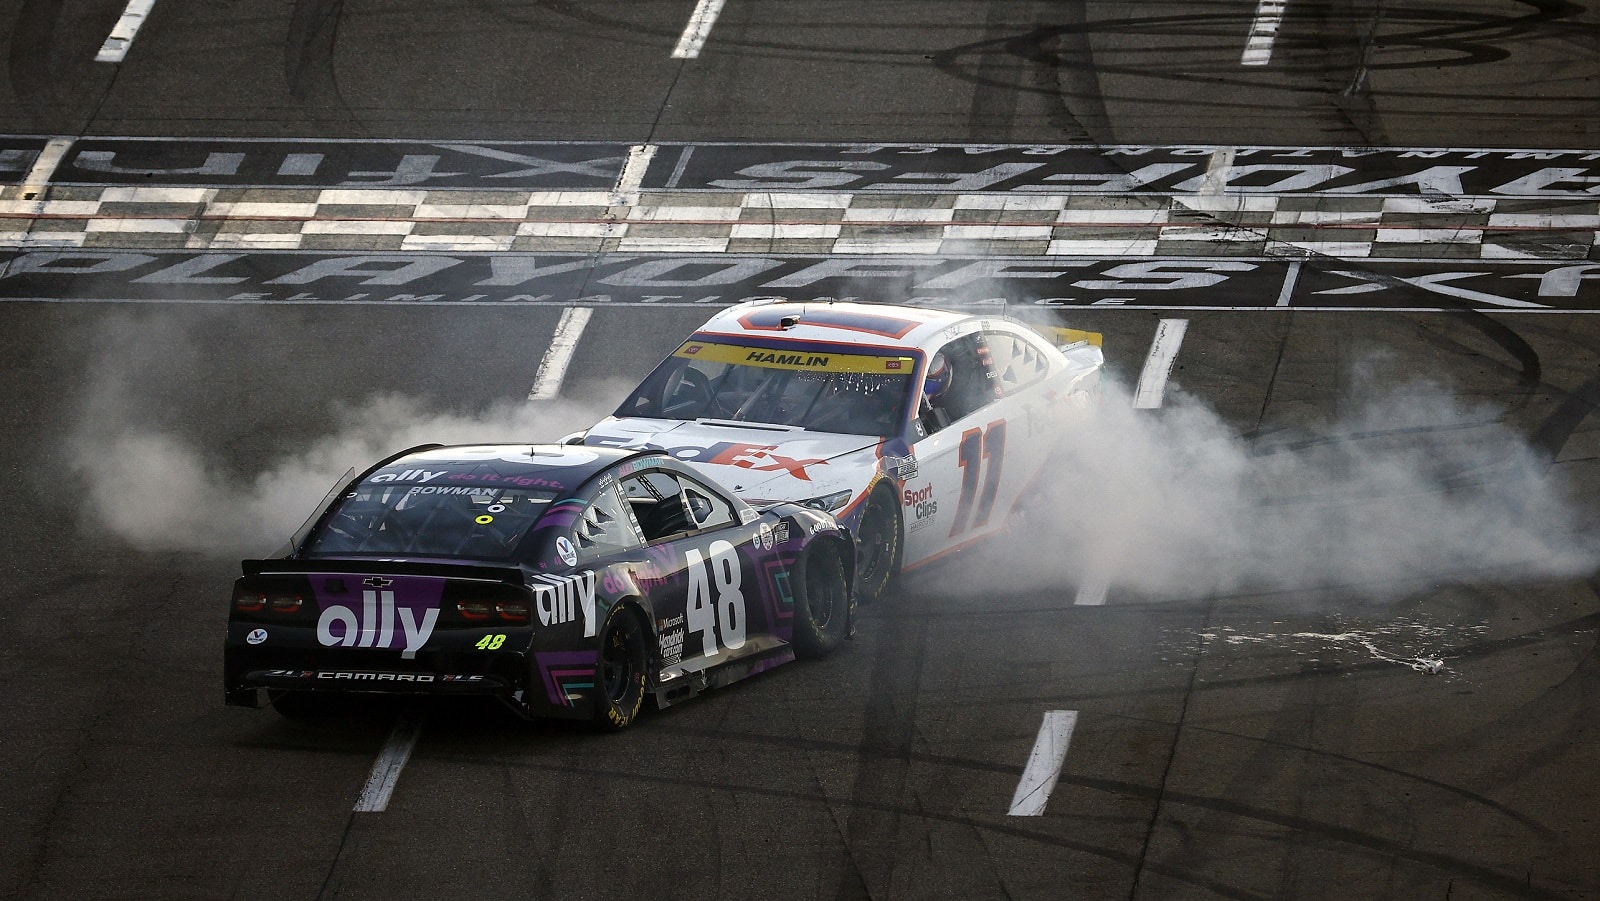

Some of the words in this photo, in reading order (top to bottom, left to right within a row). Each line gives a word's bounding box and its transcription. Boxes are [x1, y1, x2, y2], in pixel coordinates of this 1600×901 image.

[1, 251, 1262, 290] PLAYOFFS
[744, 350, 829, 368] HAMLIN
[369, 468, 449, 484] ally
[448, 473, 477, 481] do
[478, 473, 499, 481] it
[948, 419, 1006, 538] 11
[407, 485, 499, 499] BOWMAN
[904, 482, 933, 508] Sport
[915, 500, 938, 520] Clips
[531, 570, 597, 638] ally
[685, 540, 747, 657] 48
[316, 590, 440, 660] ally
[664, 612, 684, 629] Microsoft
[475, 635, 507, 650] 48
[317, 672, 435, 683] CAMARO
